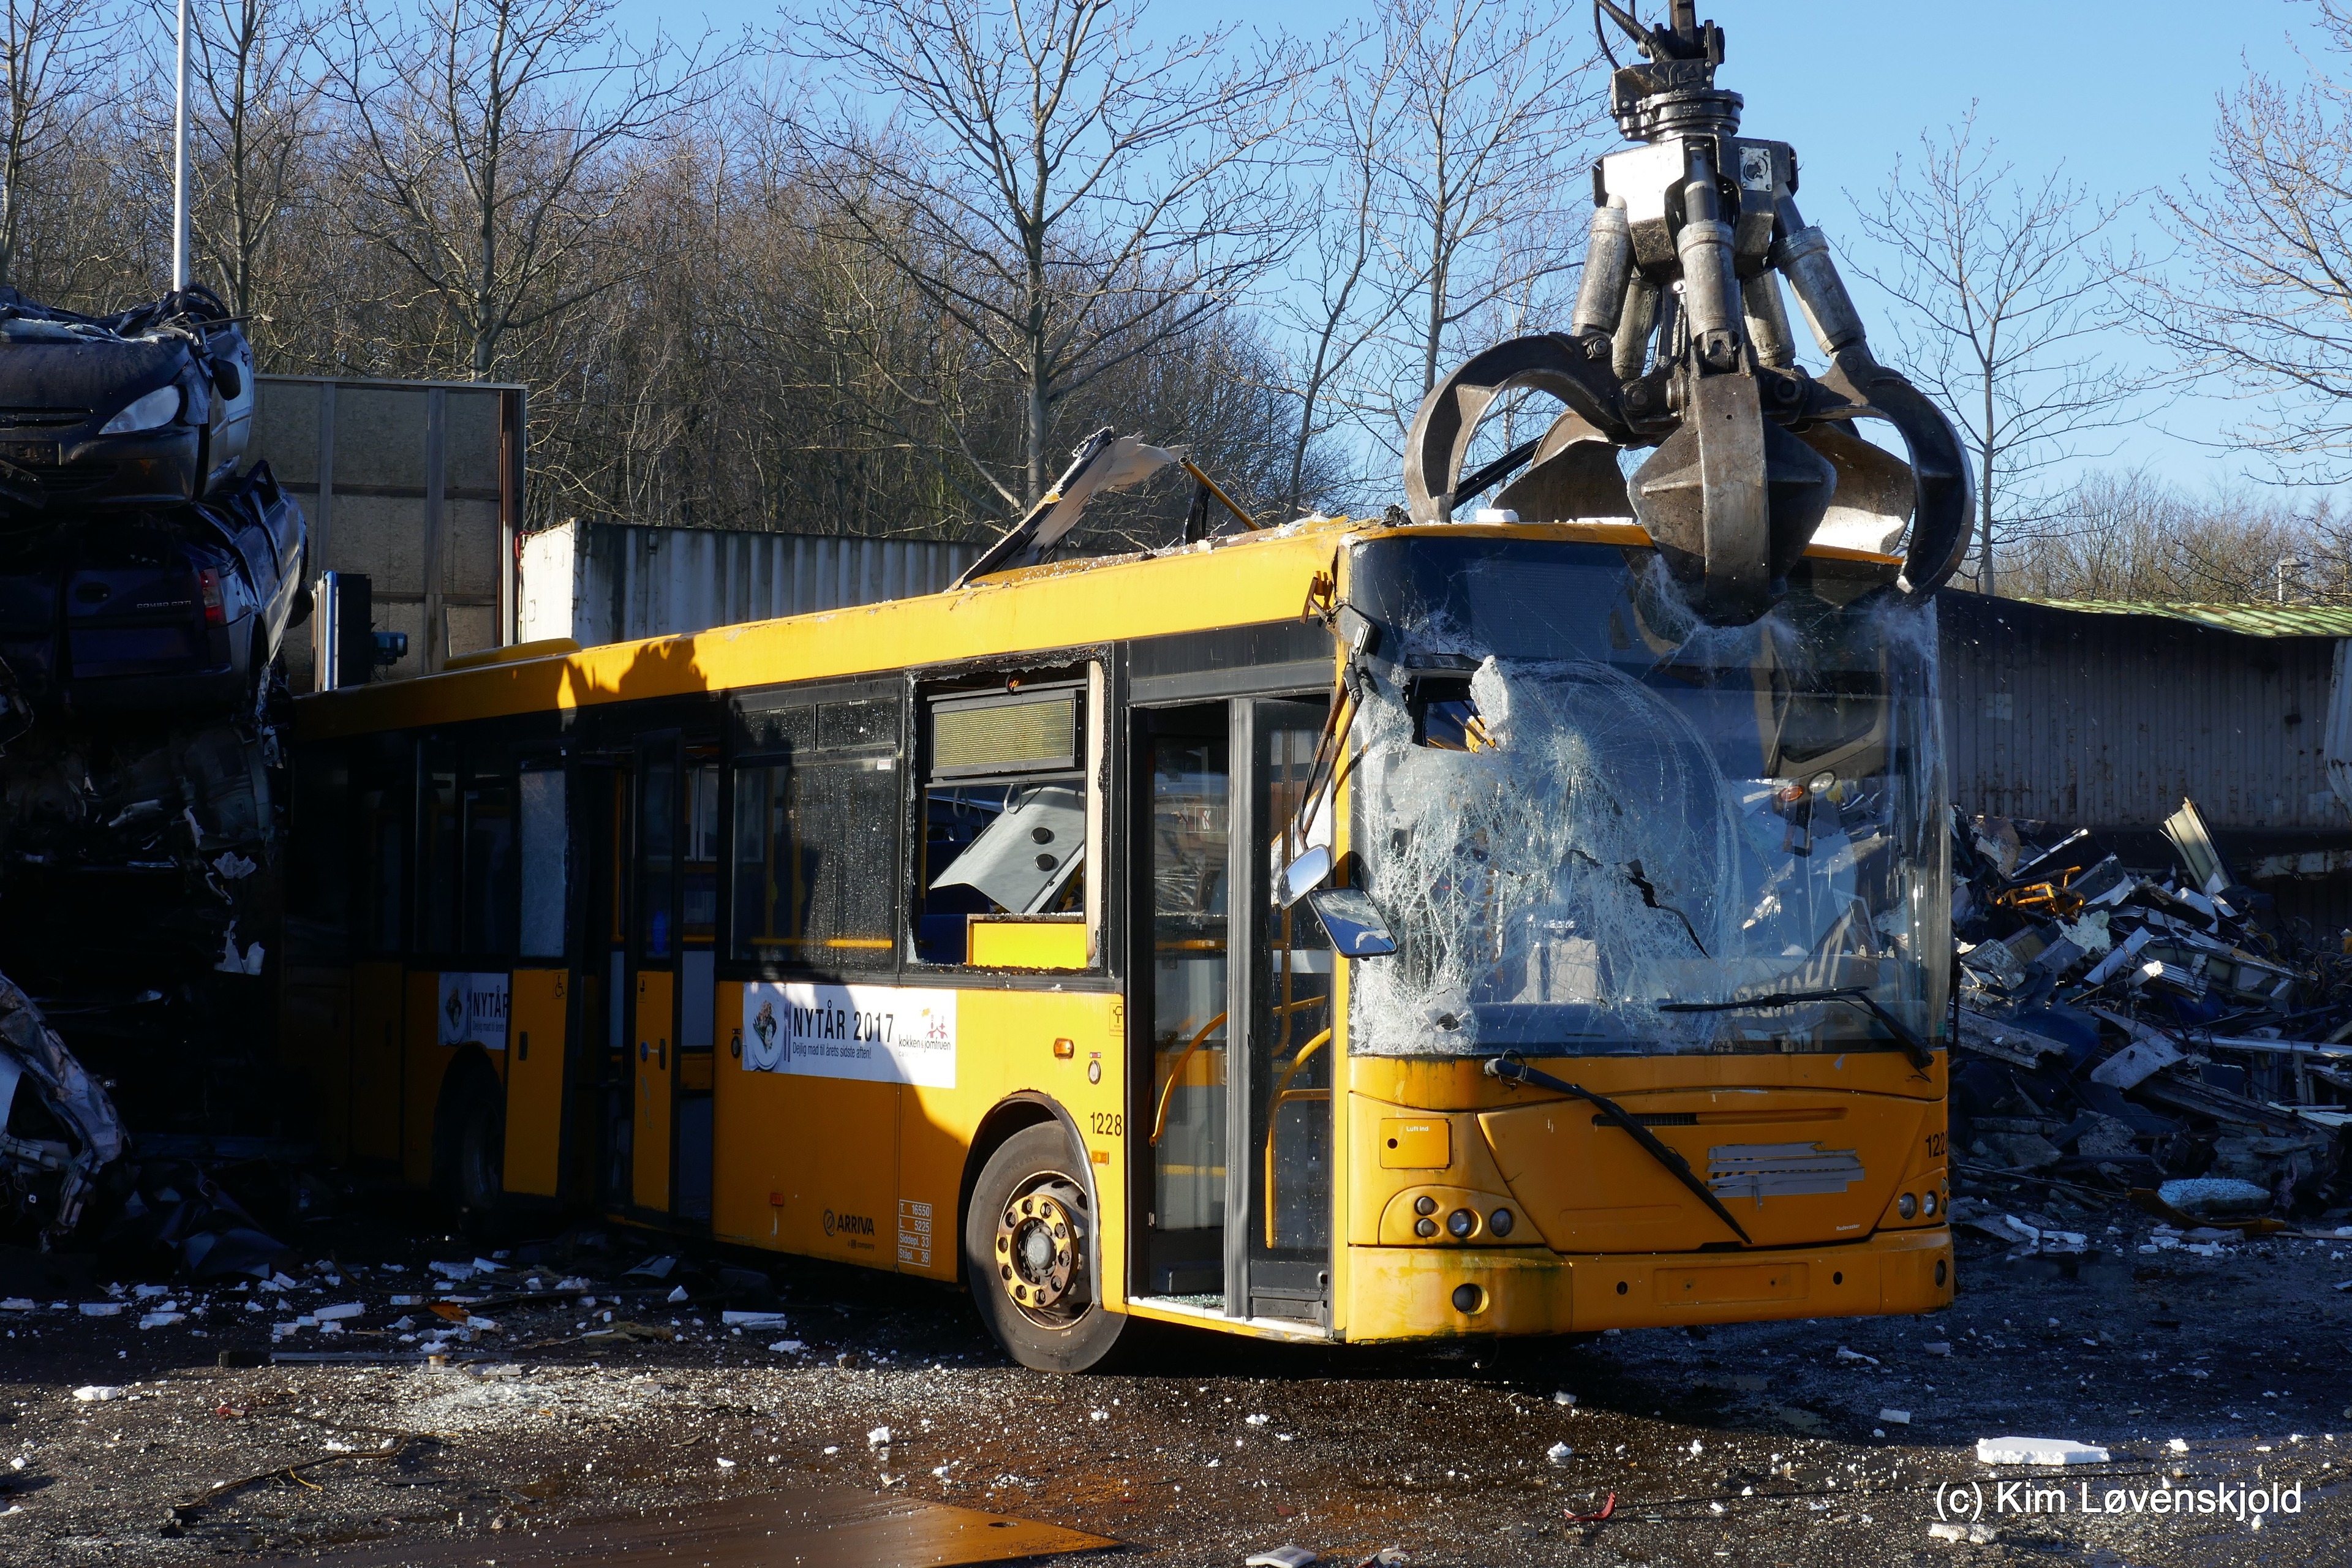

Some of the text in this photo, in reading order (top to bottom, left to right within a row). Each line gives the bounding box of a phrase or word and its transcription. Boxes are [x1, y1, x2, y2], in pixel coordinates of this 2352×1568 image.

[473, 985, 508, 1018] NYTÅR
[794, 999, 894, 1042] NYTÅR 2017
[899, 1034, 921, 1048] kokken
[793, 1042, 806, 1057] Dejlig
[807, 1044, 819, 1055] mad
[826, 1042, 839, 1057] årets
[840, 1045, 856, 1058] sidste
[856, 1046, 872, 1059] aften!
[1090, 1112, 1122, 1137] 1228
[1925, 1129, 1948, 1158] 122
[911, 1204, 930, 1217] 16550
[837, 1214, 875, 1236] ARRIVA
[914, 1219, 930, 1232] 5225
[921, 1235, 929, 1248] 33
[921, 1251, 929, 1263] 39
